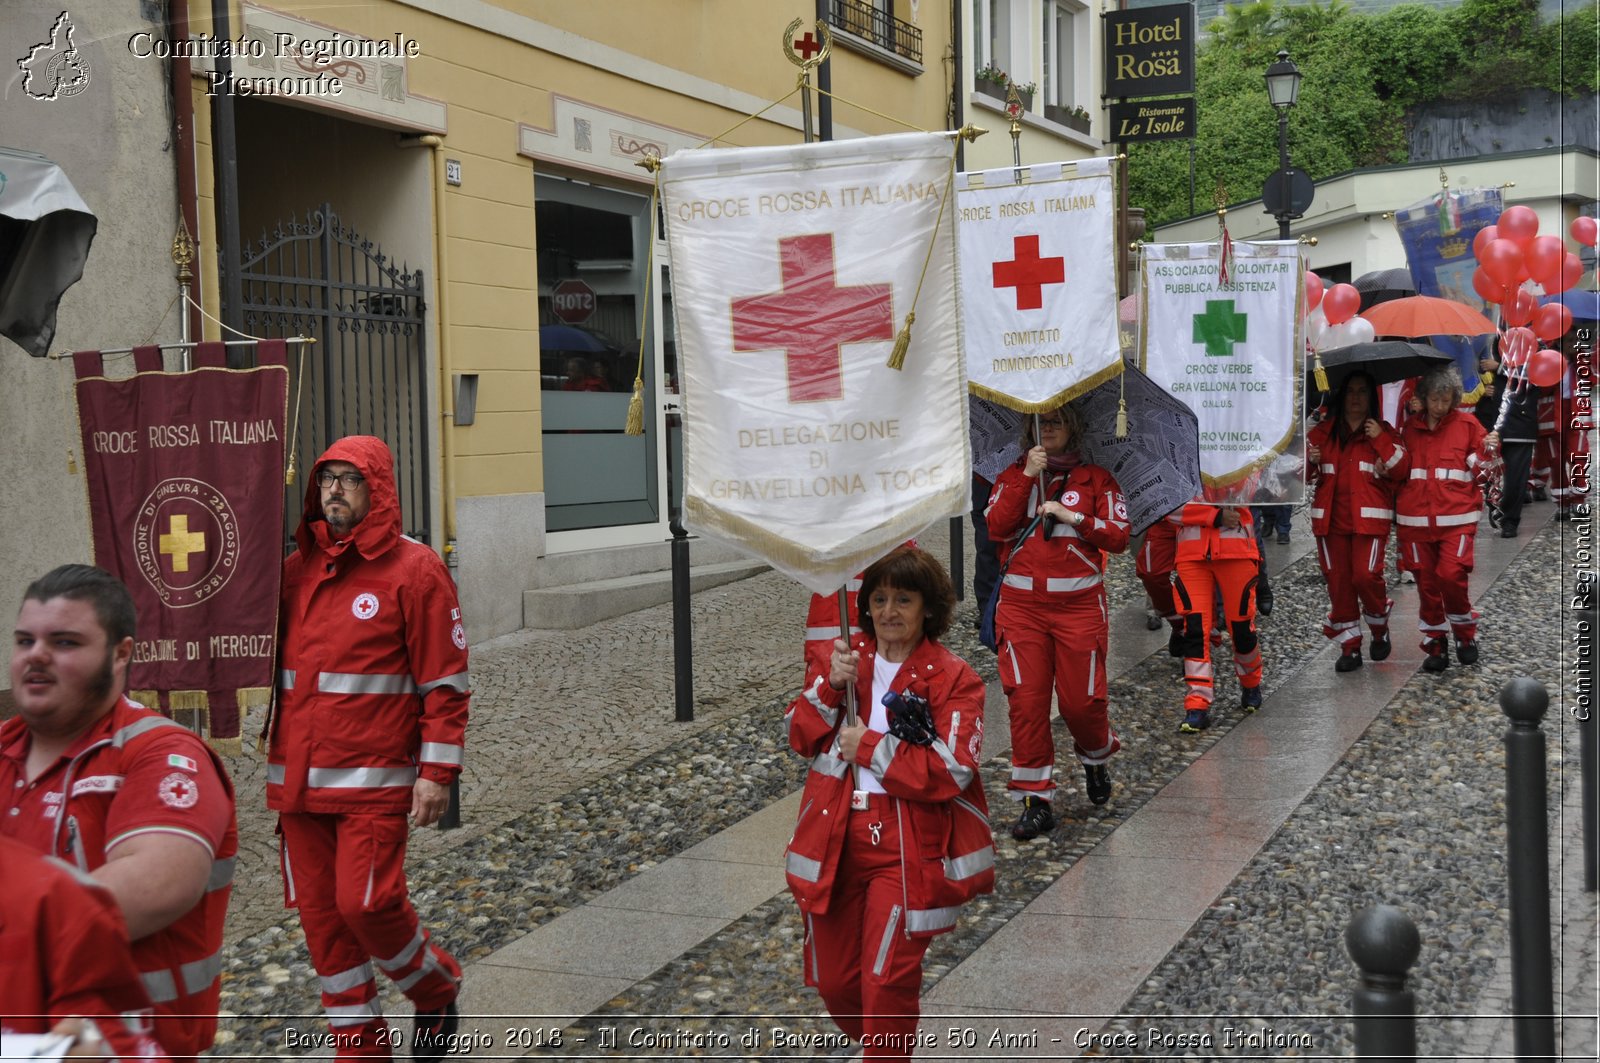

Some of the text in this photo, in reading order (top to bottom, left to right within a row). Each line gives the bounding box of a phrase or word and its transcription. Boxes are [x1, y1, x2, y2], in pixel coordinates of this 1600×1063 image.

[1115, 17, 1182, 46] Hotel
[1115, 54, 1182, 80] Rosa
[1138, 106, 1185, 117] Ristorante
[1119, 116, 1185, 136] Le Isole
[448, 164, 460, 180] 21
[678, 182, 939, 222] CROCE ROSSA ITALIANA
[1000, 200, 1035, 218] ROSSA
[1045, 194, 1096, 213] ITALIANA
[1155, 265, 1221, 277] ASSOCIAZION
[1165, 281, 1277, 294] PUBBLICA ASSISTENZA
[1004, 328, 1060, 347] COMITATO
[993, 353, 1074, 373] DOMODOSSOLA
[1185, 364, 1253, 374] CROCE VERDE
[1171, 382, 1267, 392] GRAVELLONA TOCE
[1202, 400, 1234, 408] O.N.L.U.S.
[93, 419, 278, 454] CROCE ROSSA ITALIANA
[739, 419, 901, 448] DELEGAZIONE
[1200, 432, 1262, 442] ROVINCIA
[156, 483, 199, 500] GINEVRA
[709, 465, 946, 500] GRAVELLONA TOCE
[145, 503, 156, 516] DI
[209, 496, 225, 512] 22
[220, 512, 235, 567] AGOSTO
[195, 574, 223, 599] 1864
[187, 641, 200, 660] DI
